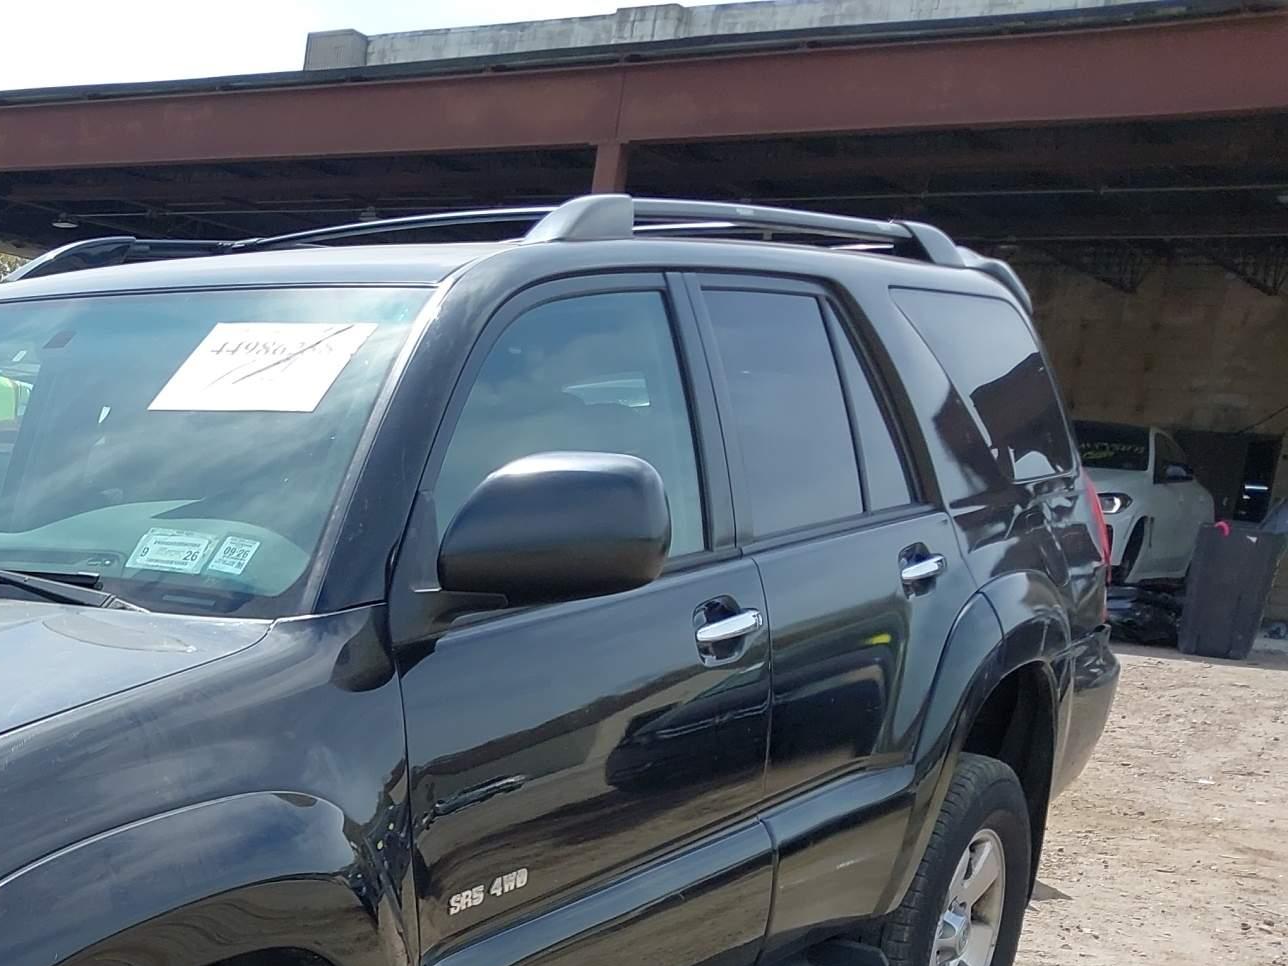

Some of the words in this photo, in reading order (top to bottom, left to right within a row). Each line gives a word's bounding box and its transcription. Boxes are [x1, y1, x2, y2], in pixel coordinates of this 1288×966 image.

[182, 550, 200, 562] 26
[449, 885, 485, 916] SR5
[489, 868, 528, 897] 4WD
